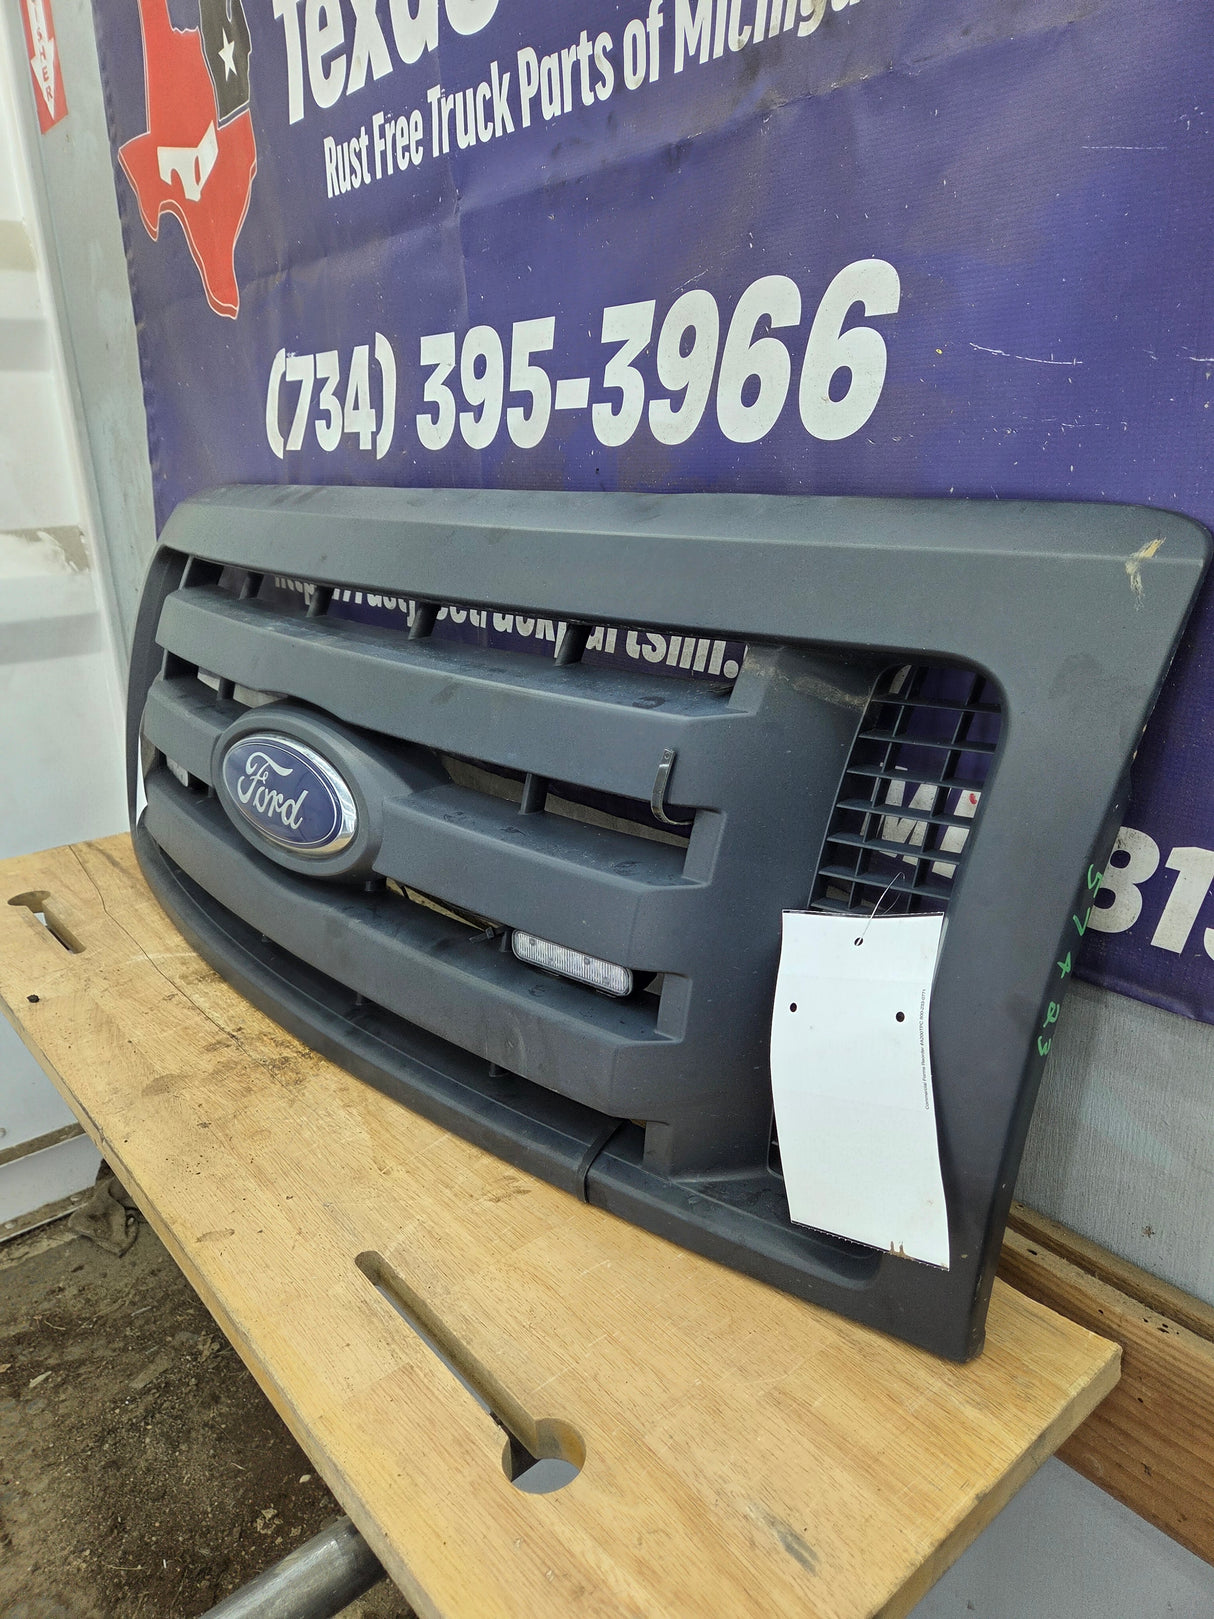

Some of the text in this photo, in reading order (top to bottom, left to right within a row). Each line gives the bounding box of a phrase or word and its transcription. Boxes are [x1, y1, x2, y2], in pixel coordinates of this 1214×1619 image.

[31, 0, 53, 102] ISHER
[323, 126, 371, 198] Rust
[372, 109, 423, 179] Free
[427, 60, 515, 158] Truck
[517, 30, 614, 128] Parts
[623, 0, 663, 90] of
[266, 258, 900, 460] (734) 395-3966
[237, 751, 309, 830] Ford
